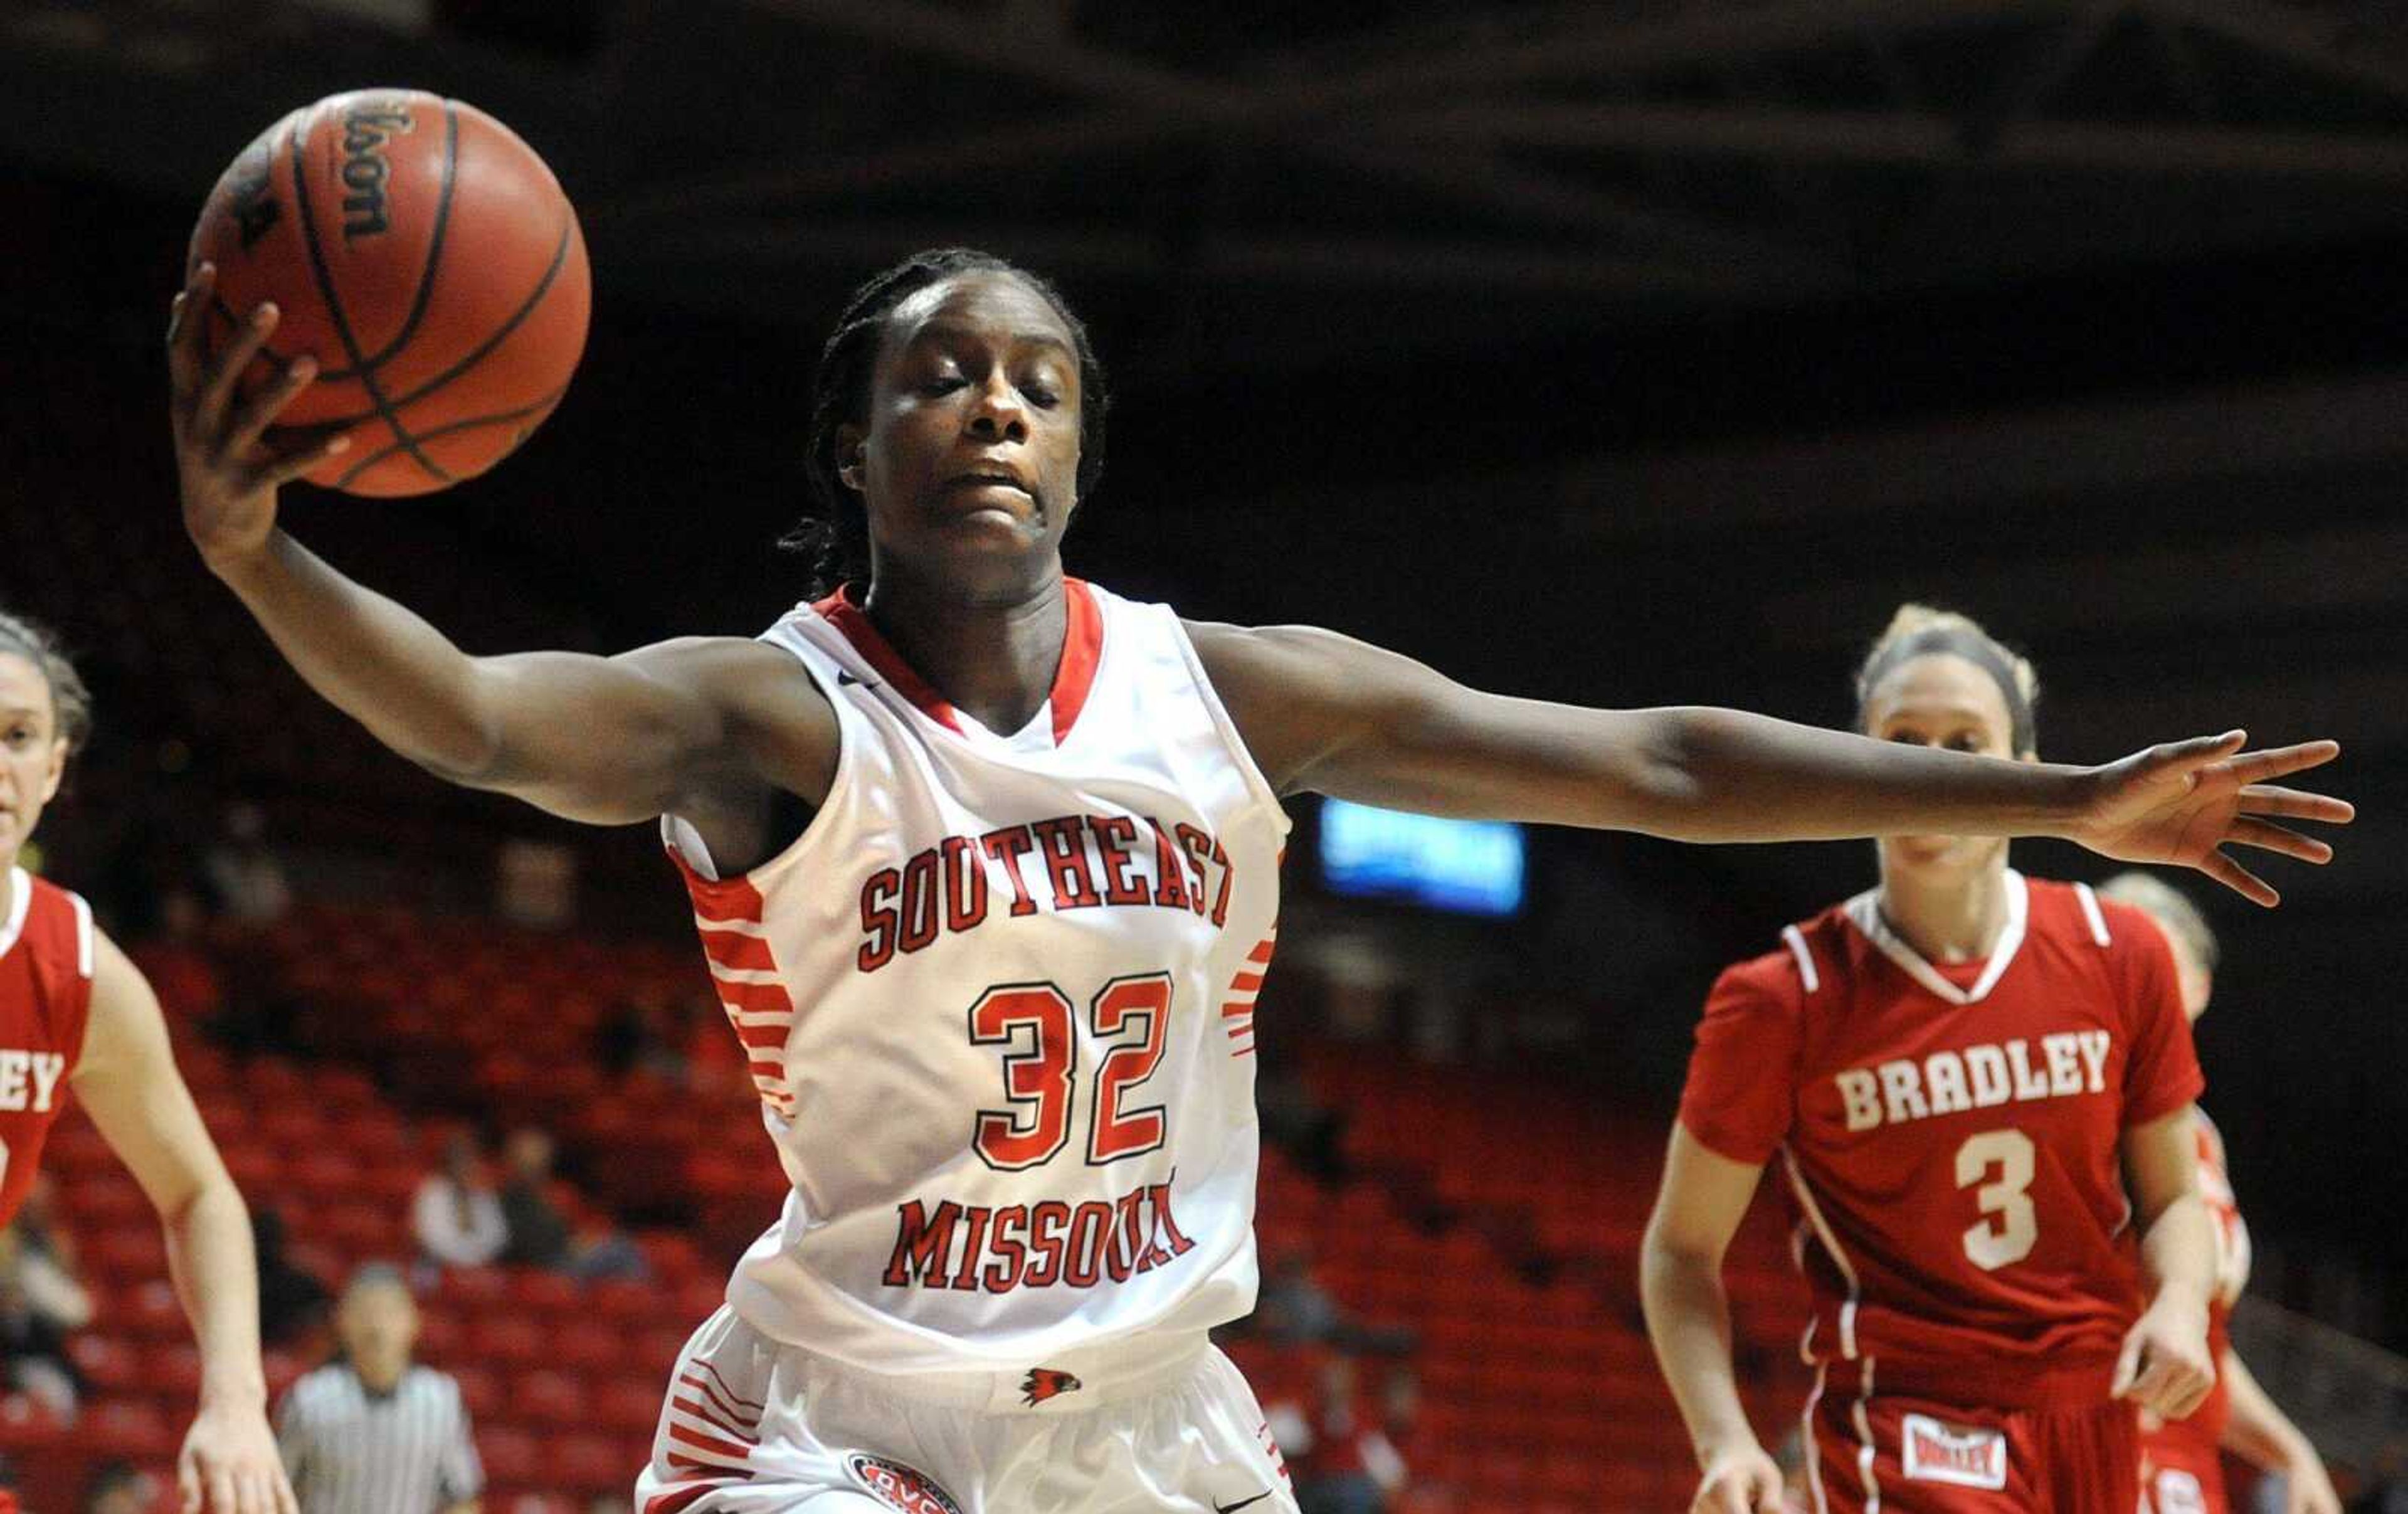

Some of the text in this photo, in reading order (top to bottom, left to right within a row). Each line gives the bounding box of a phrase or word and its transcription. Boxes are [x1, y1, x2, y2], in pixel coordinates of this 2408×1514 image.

[968, 970, 1174, 1172] 32
[1835, 1030, 2111, 1131] BRADLEY
[882, 1167, 1196, 1294] MISSOUR
[1955, 1129, 2037, 1272] 3
